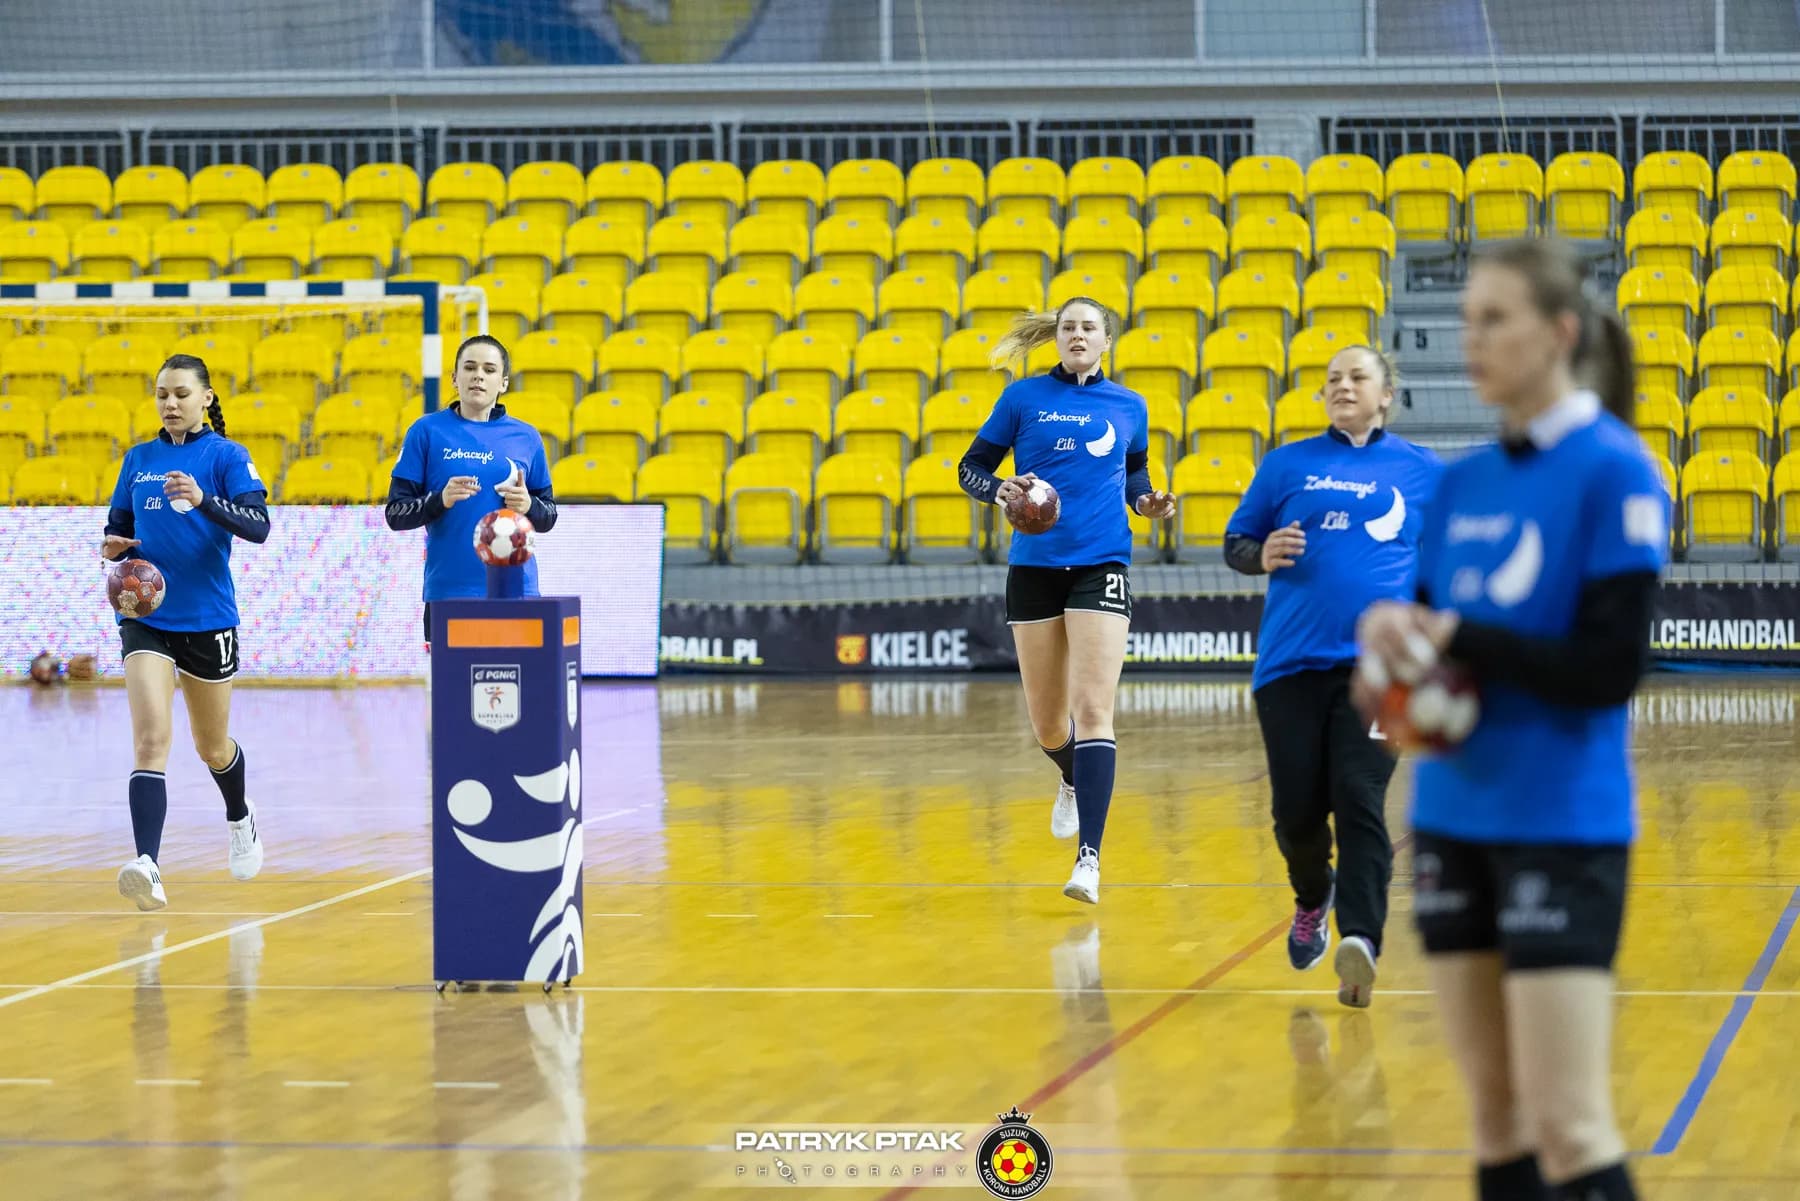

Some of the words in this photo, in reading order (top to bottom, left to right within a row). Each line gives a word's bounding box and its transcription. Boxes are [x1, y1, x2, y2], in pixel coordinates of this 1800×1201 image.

[1038, 410, 1092, 426] Zobaczyć
[1053, 437, 1077, 451] Lili
[443, 447, 494, 465] Zobaczyć
[1303, 475, 1377, 499] Zobaczyć
[143, 496, 164, 510] Lili
[1319, 510, 1351, 531] Lili
[1105, 573, 1126, 601] 21
[214, 629, 233, 665] 17
[870, 628, 970, 667] KIELCE
